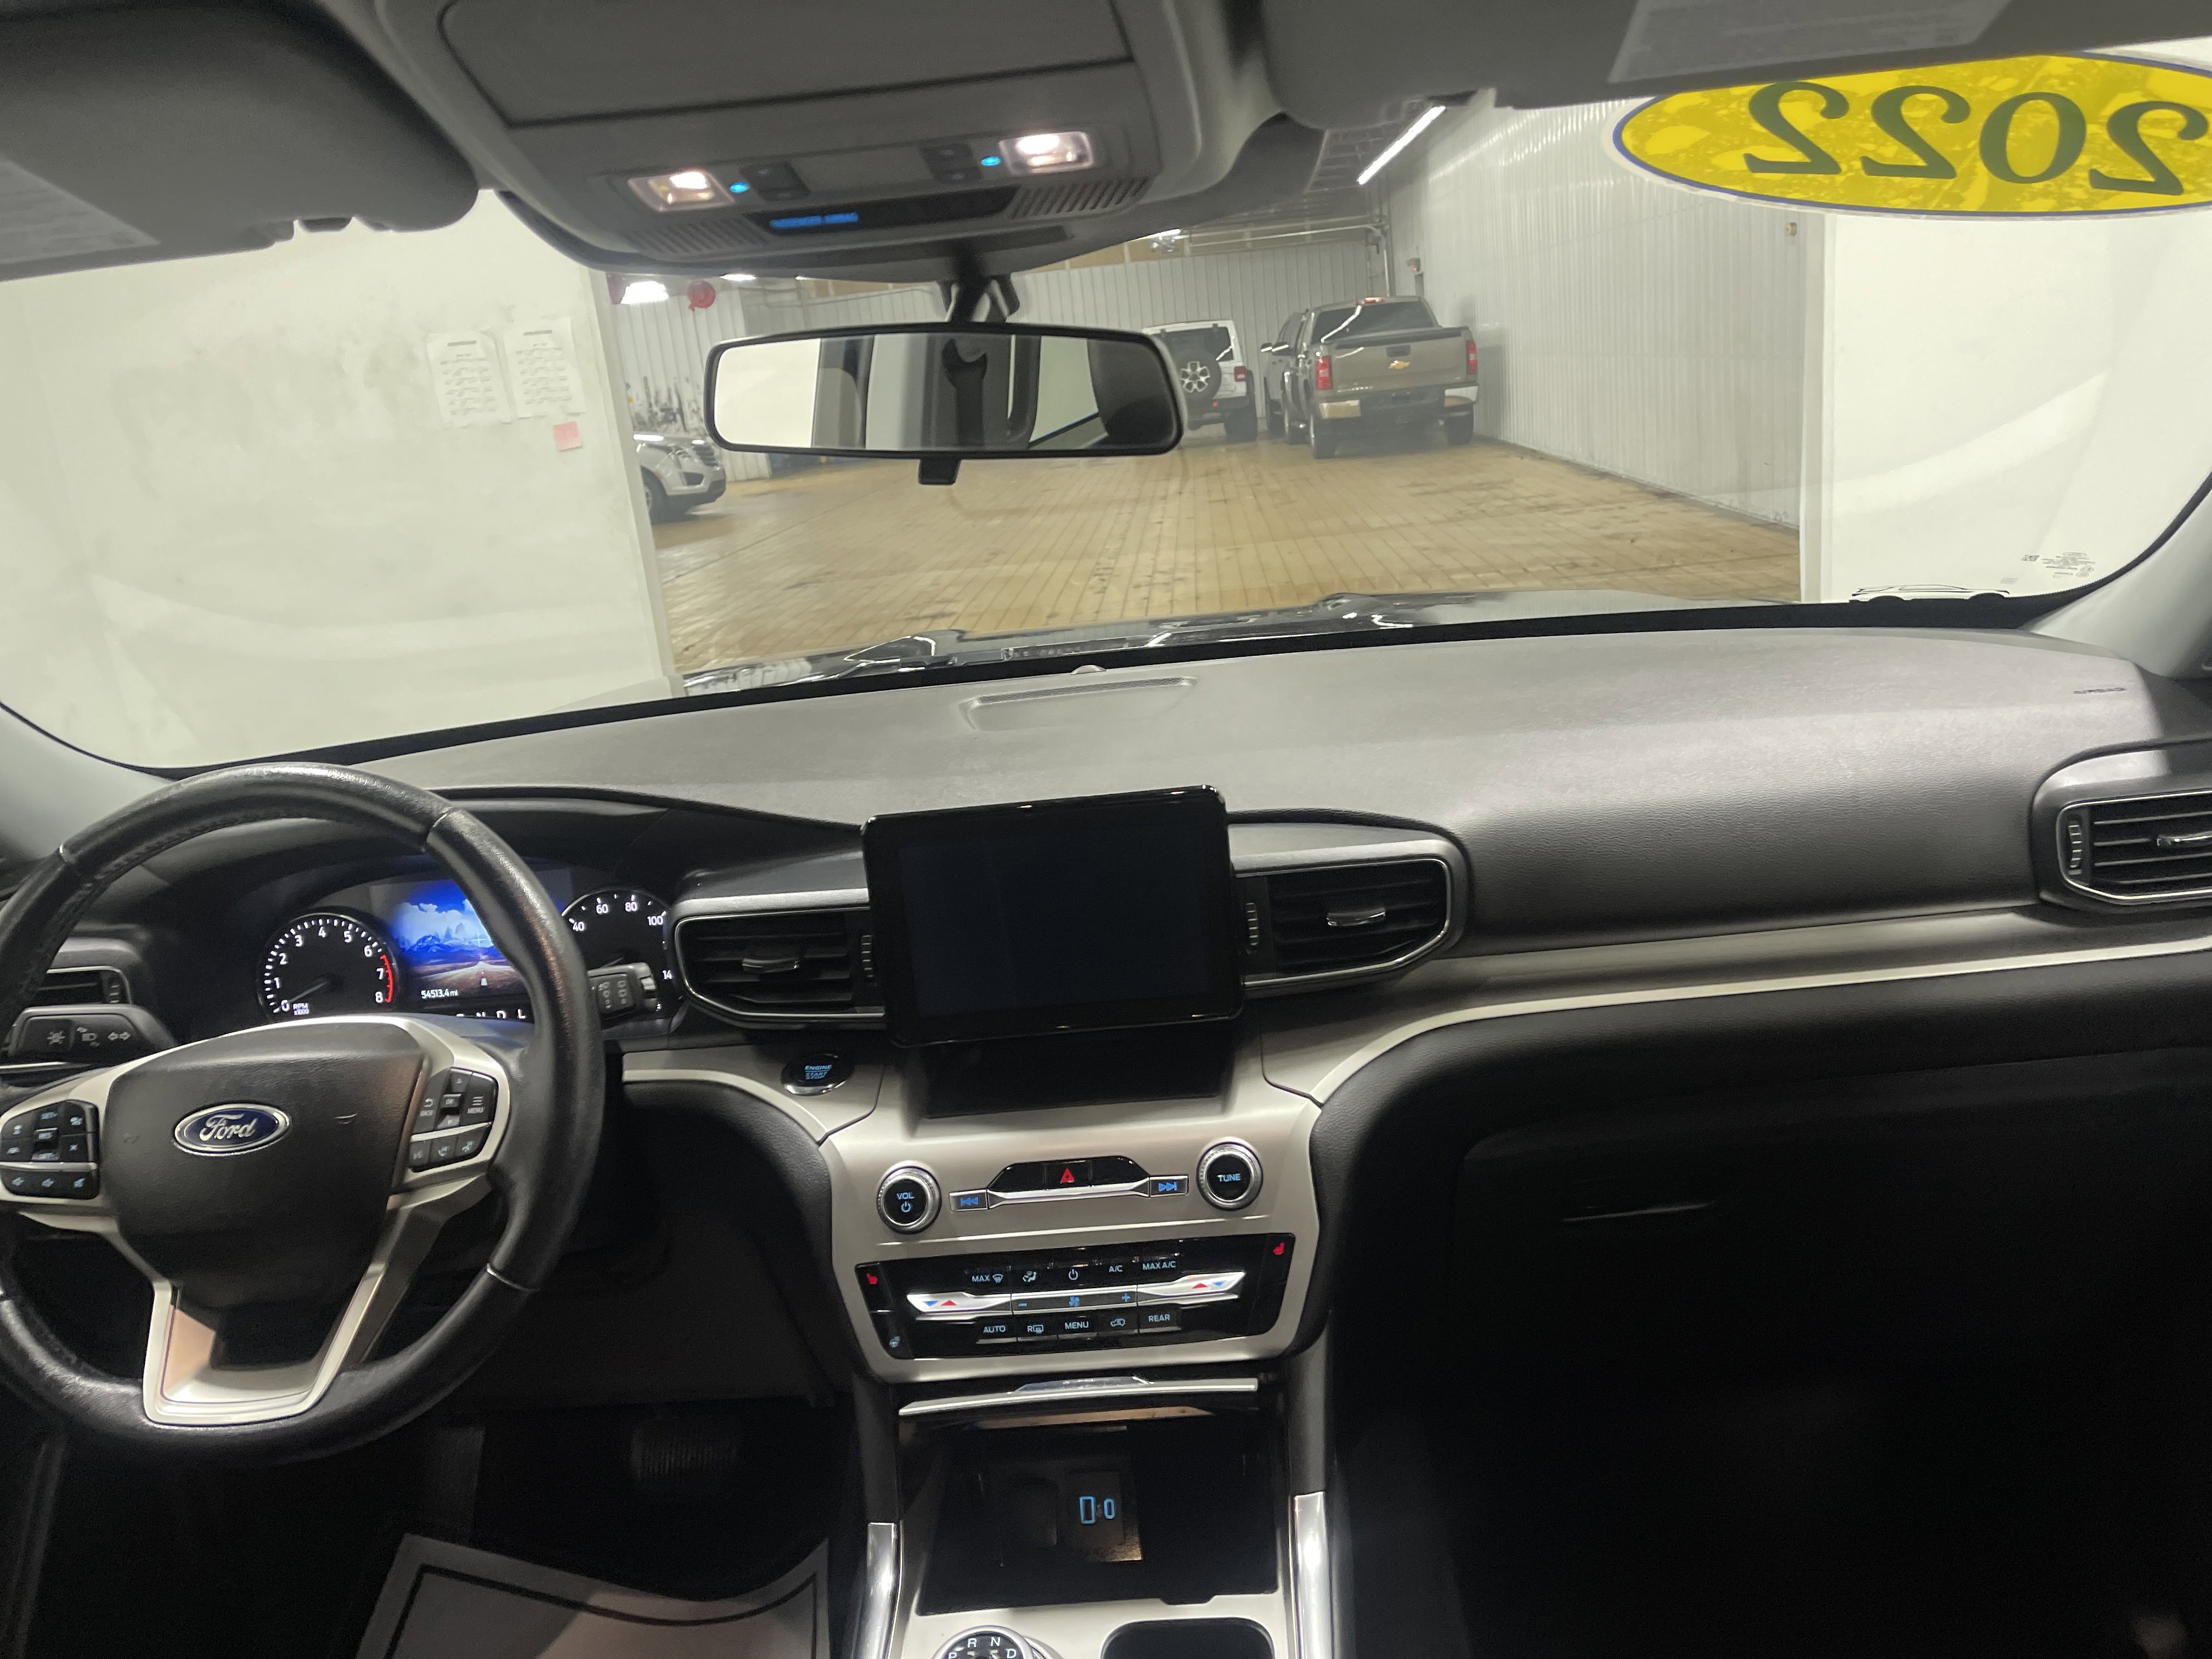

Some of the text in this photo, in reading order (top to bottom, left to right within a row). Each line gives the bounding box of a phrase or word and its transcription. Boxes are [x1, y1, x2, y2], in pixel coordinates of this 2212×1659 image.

[596, 904, 608, 913] 60
[625, 901, 637, 911] 80
[572, 921, 585, 931] 40
[647, 915, 663, 926] 100
[318, 927, 326, 938] 4
[343, 930, 352, 943] 5
[295, 935, 303, 947] 3
[364, 945, 372, 957] 6
[279, 953, 289, 964] 2
[376, 968, 383, 979] 7
[662, 970, 673, 980] 14
[274, 977, 280, 989] 1
[375, 991, 383, 1003] 8
[281, 1000, 289, 1011] 0
[199, 1113, 259, 1142] Ford
[1217, 1173, 1241, 1182] TUNE
[1109, 1264, 1122, 1273] A/C
[1143, 1260, 1176, 1271] MAX A/C
[1148, 1314, 1170, 1323] REAR
[983, 1325, 1006, 1333] AUTO
[1064, 1321, 1089, 1330] MENU
[967, 1638, 977, 1648] R
[990, 1637, 1001, 1647] N
[1006, 1648, 1017, 1659] D
